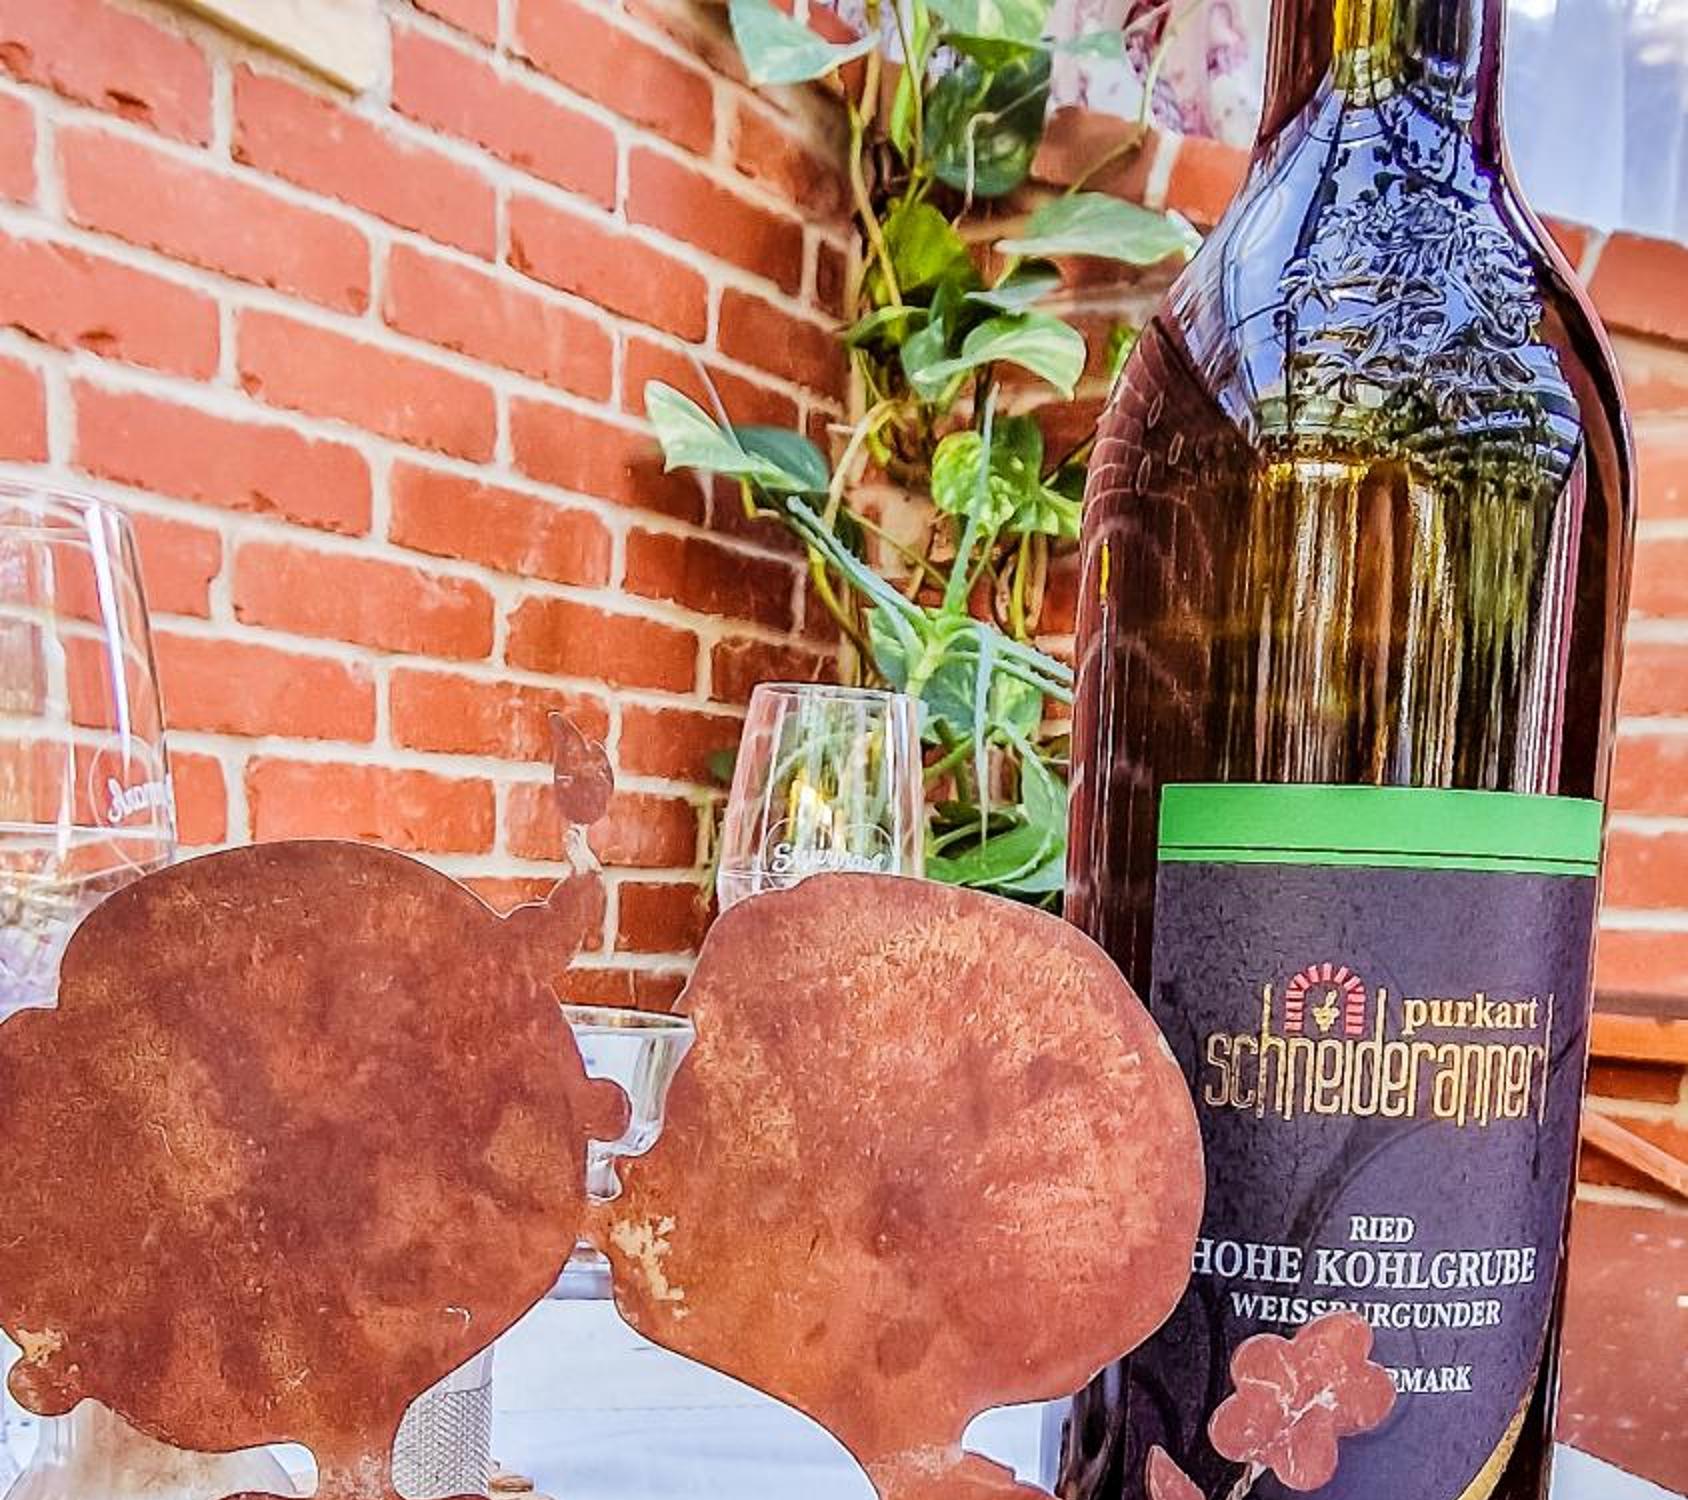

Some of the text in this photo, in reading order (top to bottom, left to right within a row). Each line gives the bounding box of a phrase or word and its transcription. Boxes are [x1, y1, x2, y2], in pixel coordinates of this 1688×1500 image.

[1401, 993, 1539, 1034] purkart
[1350, 1216, 1414, 1243] RIED
[1191, 1238, 1537, 1290] HOHE KOHLGRUBE
